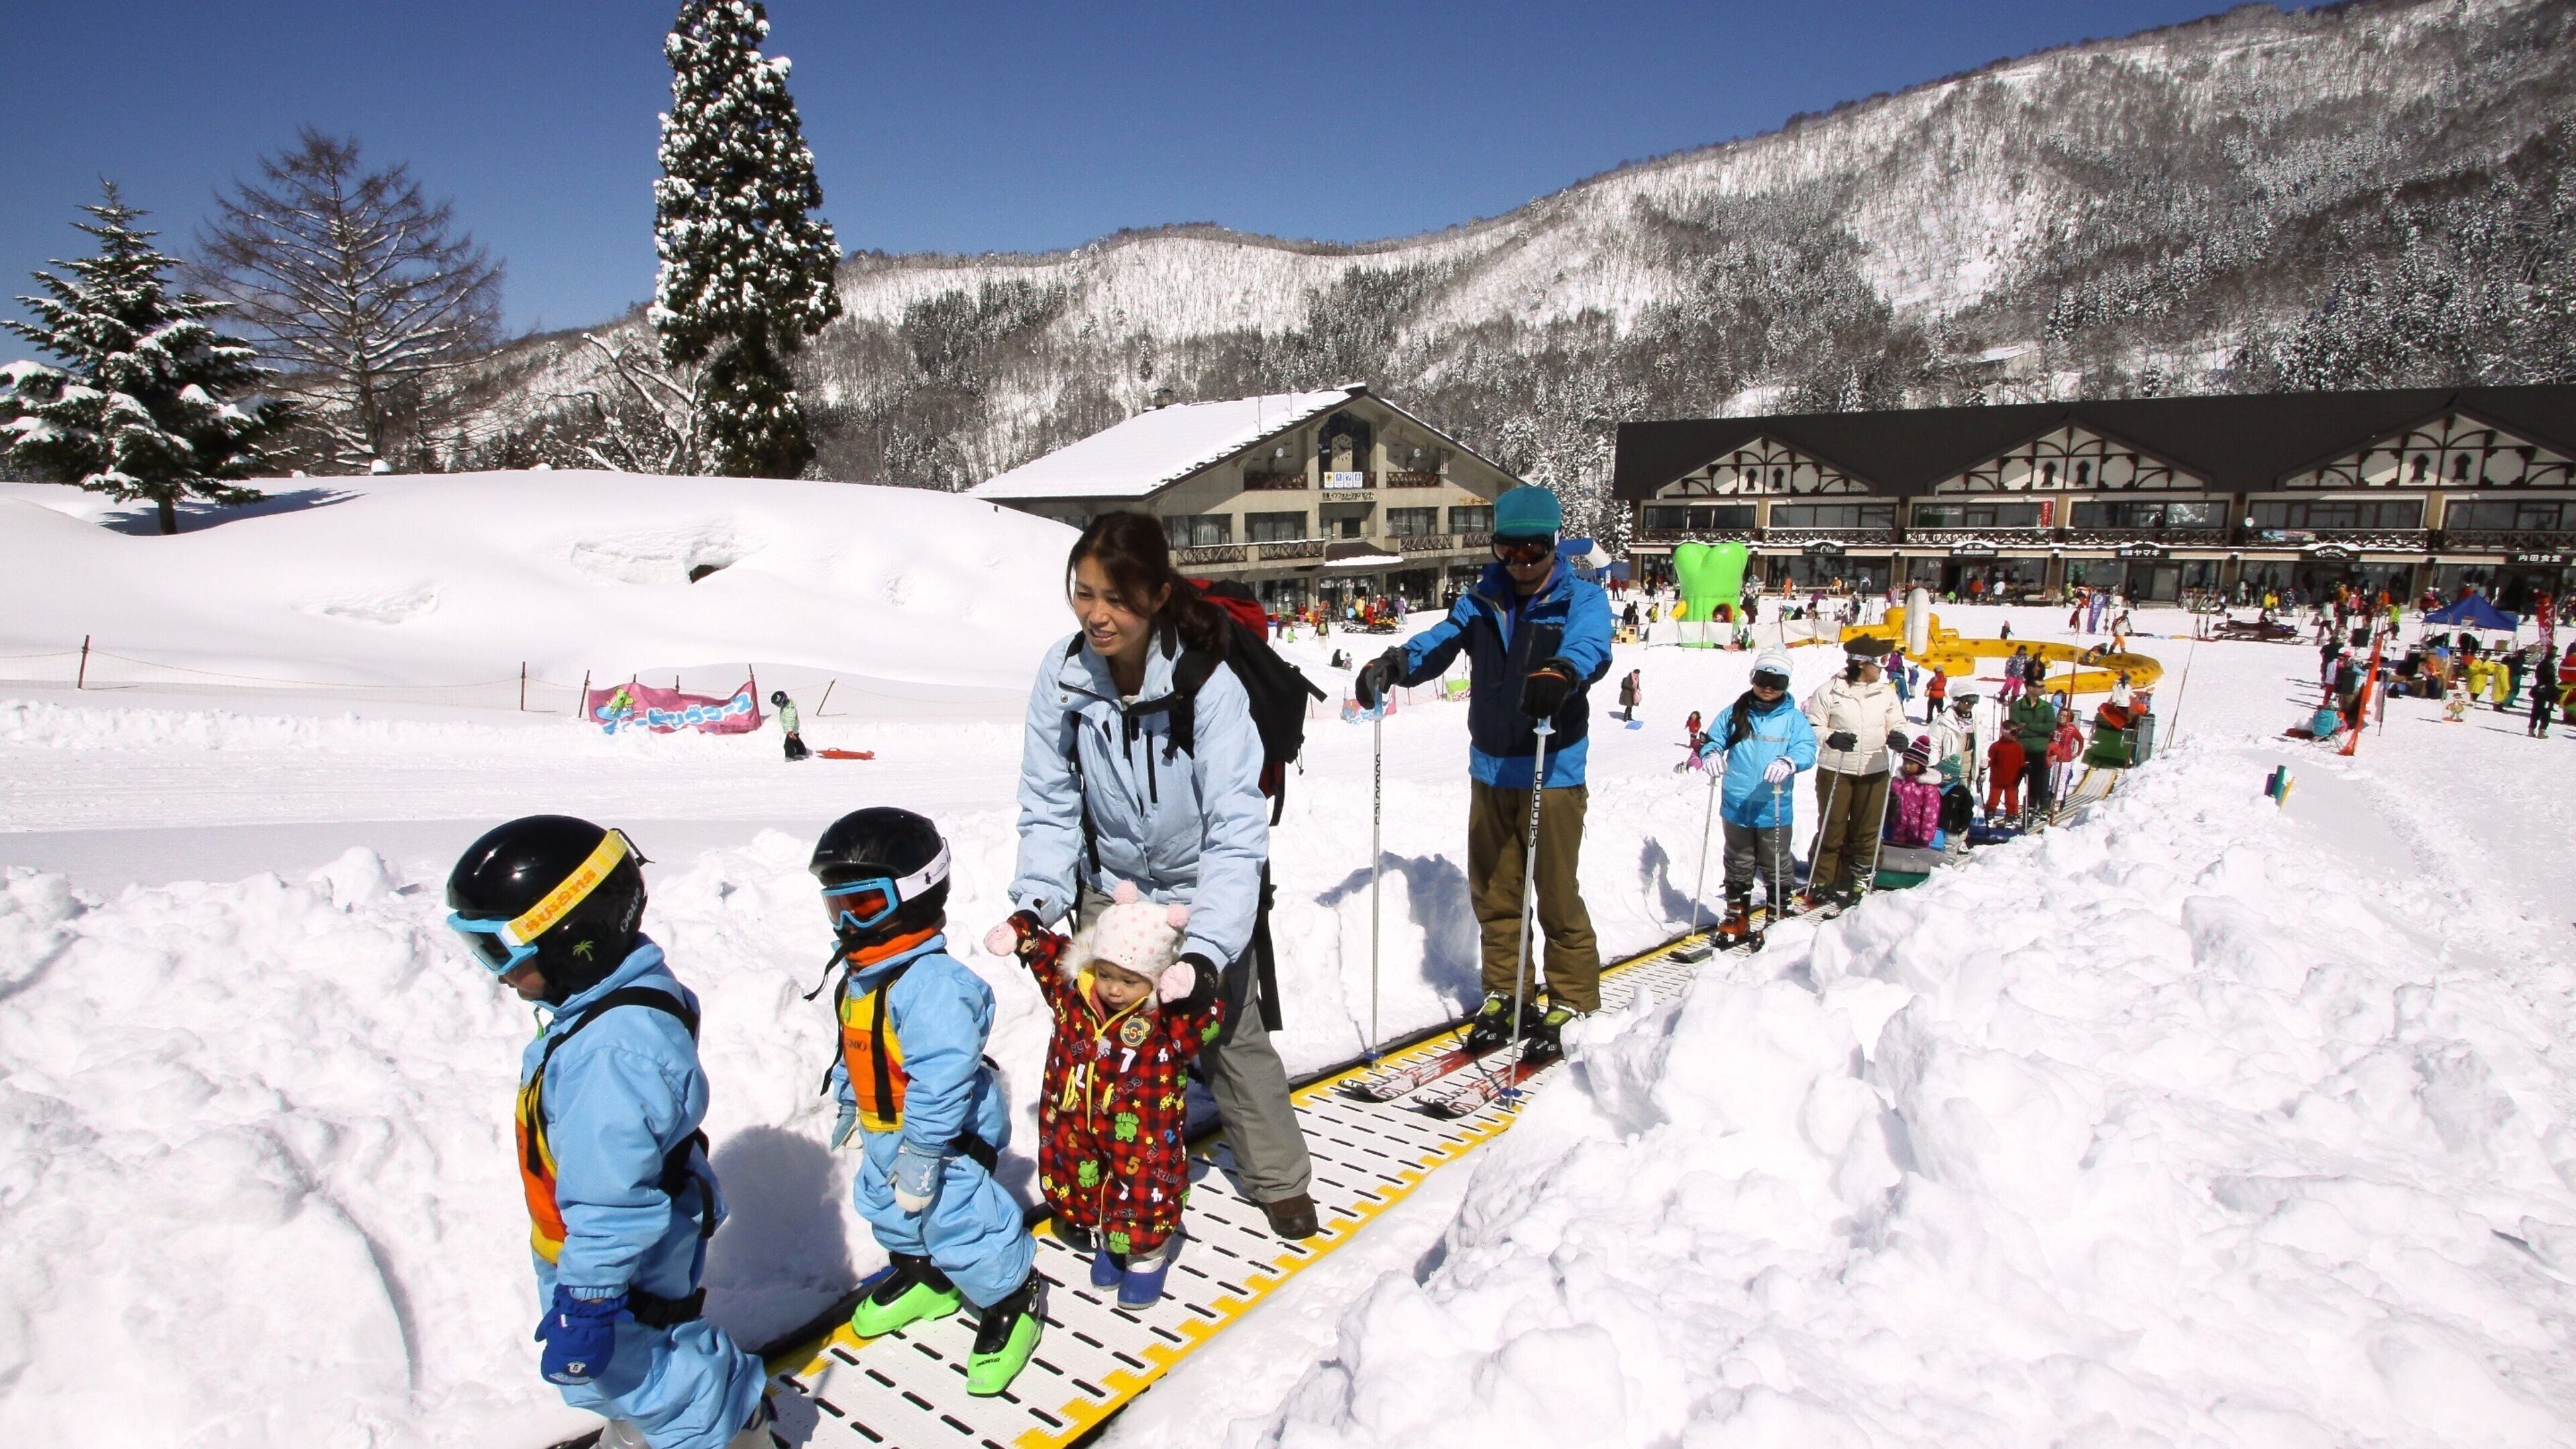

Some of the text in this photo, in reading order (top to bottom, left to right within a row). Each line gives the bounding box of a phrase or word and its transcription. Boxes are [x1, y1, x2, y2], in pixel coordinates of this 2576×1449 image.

[2134, 549, 2160, 557] ヤマキ
[2518, 554, 2562, 562] 内田食堂
[1529, 771, 1542, 847] salomon
[1120, 1047, 1136, 1073] 7
[1126, 1156, 1140, 1175] 5
